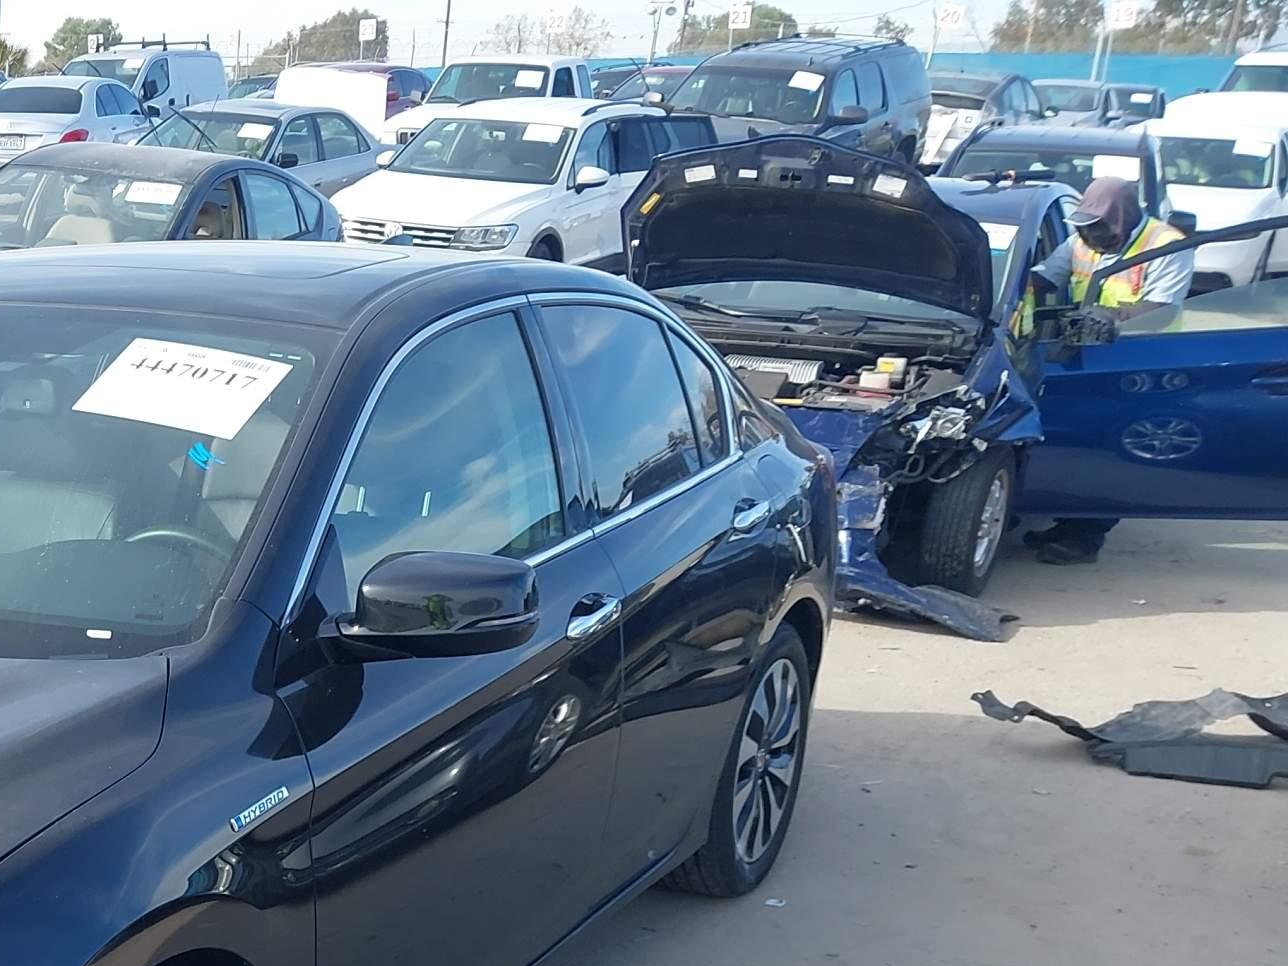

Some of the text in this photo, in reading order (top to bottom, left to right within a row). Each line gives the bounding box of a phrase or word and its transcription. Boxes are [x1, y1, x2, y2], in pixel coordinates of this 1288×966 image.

[548, 15, 564, 29] 22
[731, 10, 748, 24] 21
[940, 8, 961, 24] 20
[129, 356, 260, 390] 44470717
[242, 789, 285, 827] HYBRID
